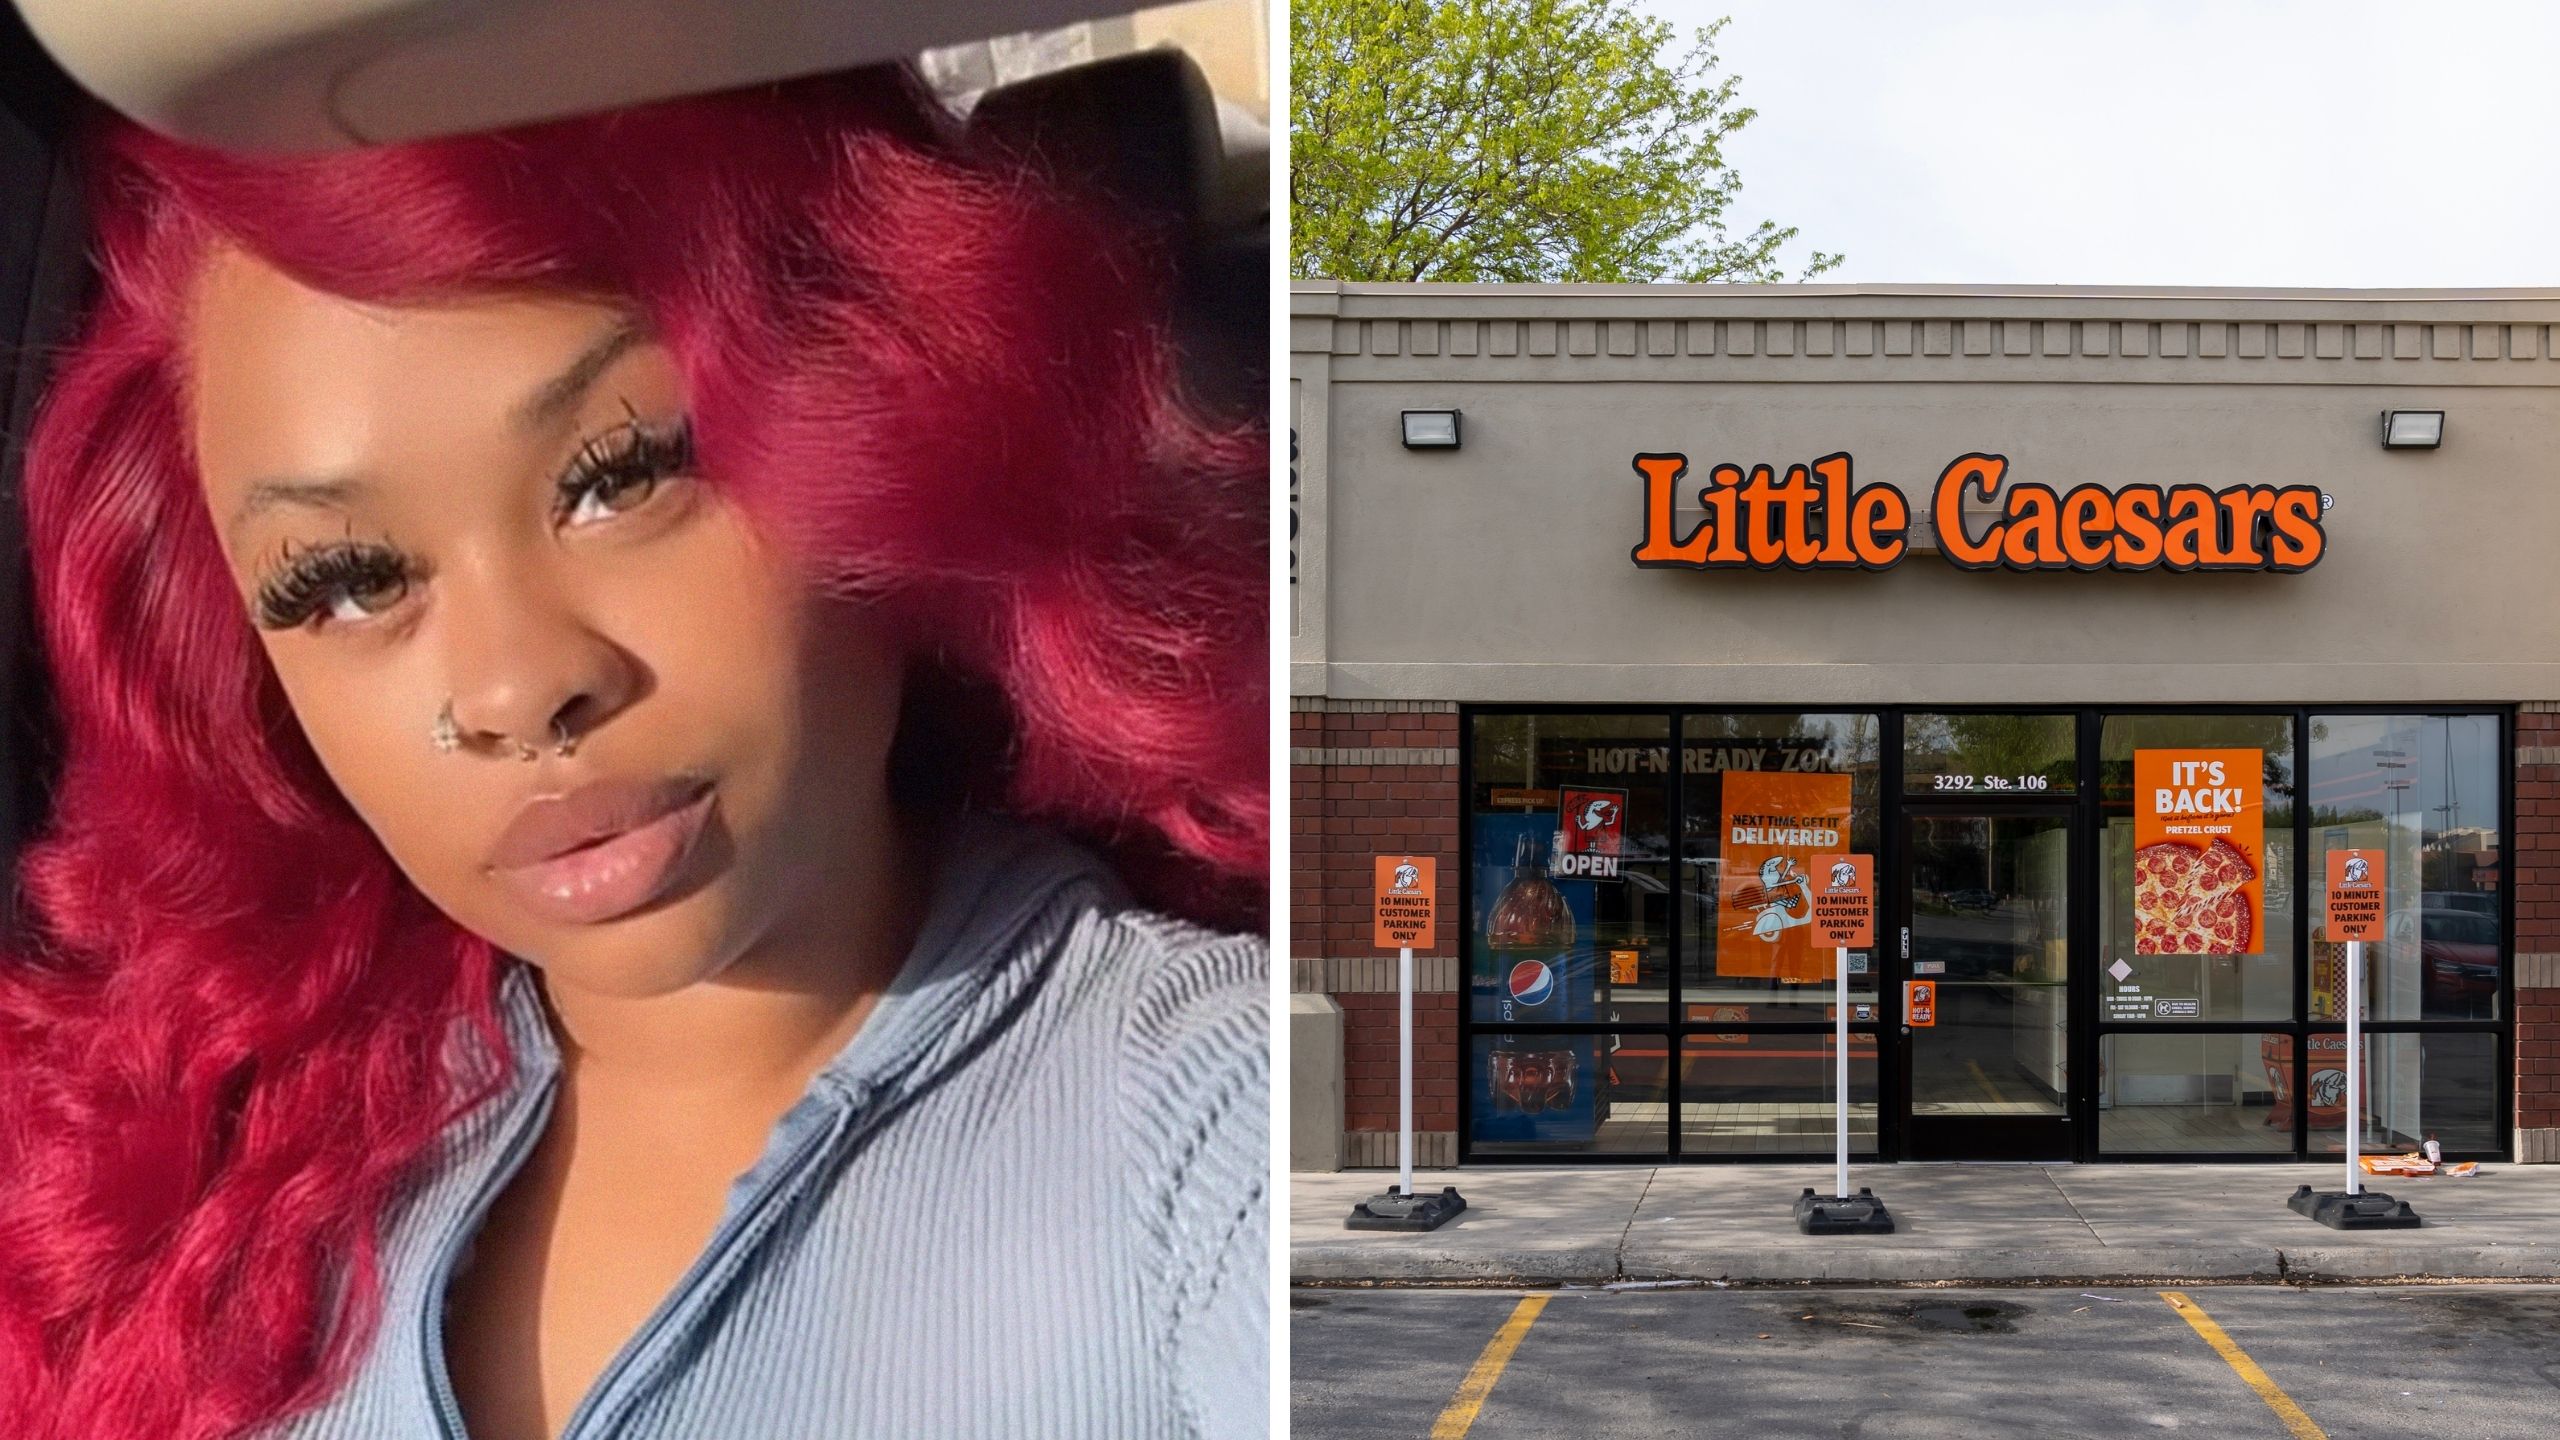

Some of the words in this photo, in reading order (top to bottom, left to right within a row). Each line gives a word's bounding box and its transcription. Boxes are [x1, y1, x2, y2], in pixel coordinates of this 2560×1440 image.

[1632, 453, 1910, 569] Little
[1932, 453, 2326, 570] Caesars
[2172, 761, 2226, 786] IT'S
[1934, 775, 1974, 790] 3292
[1984, 775, 2013, 790] Ste.
[2018, 775, 2048, 790] 106
[2155, 788, 2243, 813] BACK!
[1732, 815, 1765, 827] NEXT
[1767, 815, 1799, 829] TIME,
[1802, 817, 1825, 827] GET
[1827, 817, 1839, 827] IT
[2166, 825, 2203, 834] PRETZEL
[2204, 825, 2232, 834] CRUST
[1731, 827, 1839, 847] DELIVERED
[1561, 854, 1618, 877] OPEN
[2331, 890, 2342, 899] 10
[2343, 890, 2380, 899] MINUTE
[1380, 896, 1391, 905] 10
[1393, 897, 1430, 906] MINUTE
[1816, 896, 1828, 905] 10
[1829, 896, 1868, 905] MINUTE
[2330, 902, 2381, 911] CUSTOMER
[1379, 908, 1431, 918] CUSTOMER
[1815, 907, 1869, 917] CUSTOMER
[2334, 913, 2376, 922] PARKING
[1383, 920, 1426, 929] PARKING
[1820, 919, 1864, 928] PARKING
[2343, 925, 2367, 933] ONLY
[1392, 931, 1417, 940] ONLY
[1829, 930, 1855, 939] ONLY
[2118, 985, 2140, 993] HOURS
[1502, 999, 1515, 1043] ppsi
[2323, 1037, 2364, 1050] Caess
